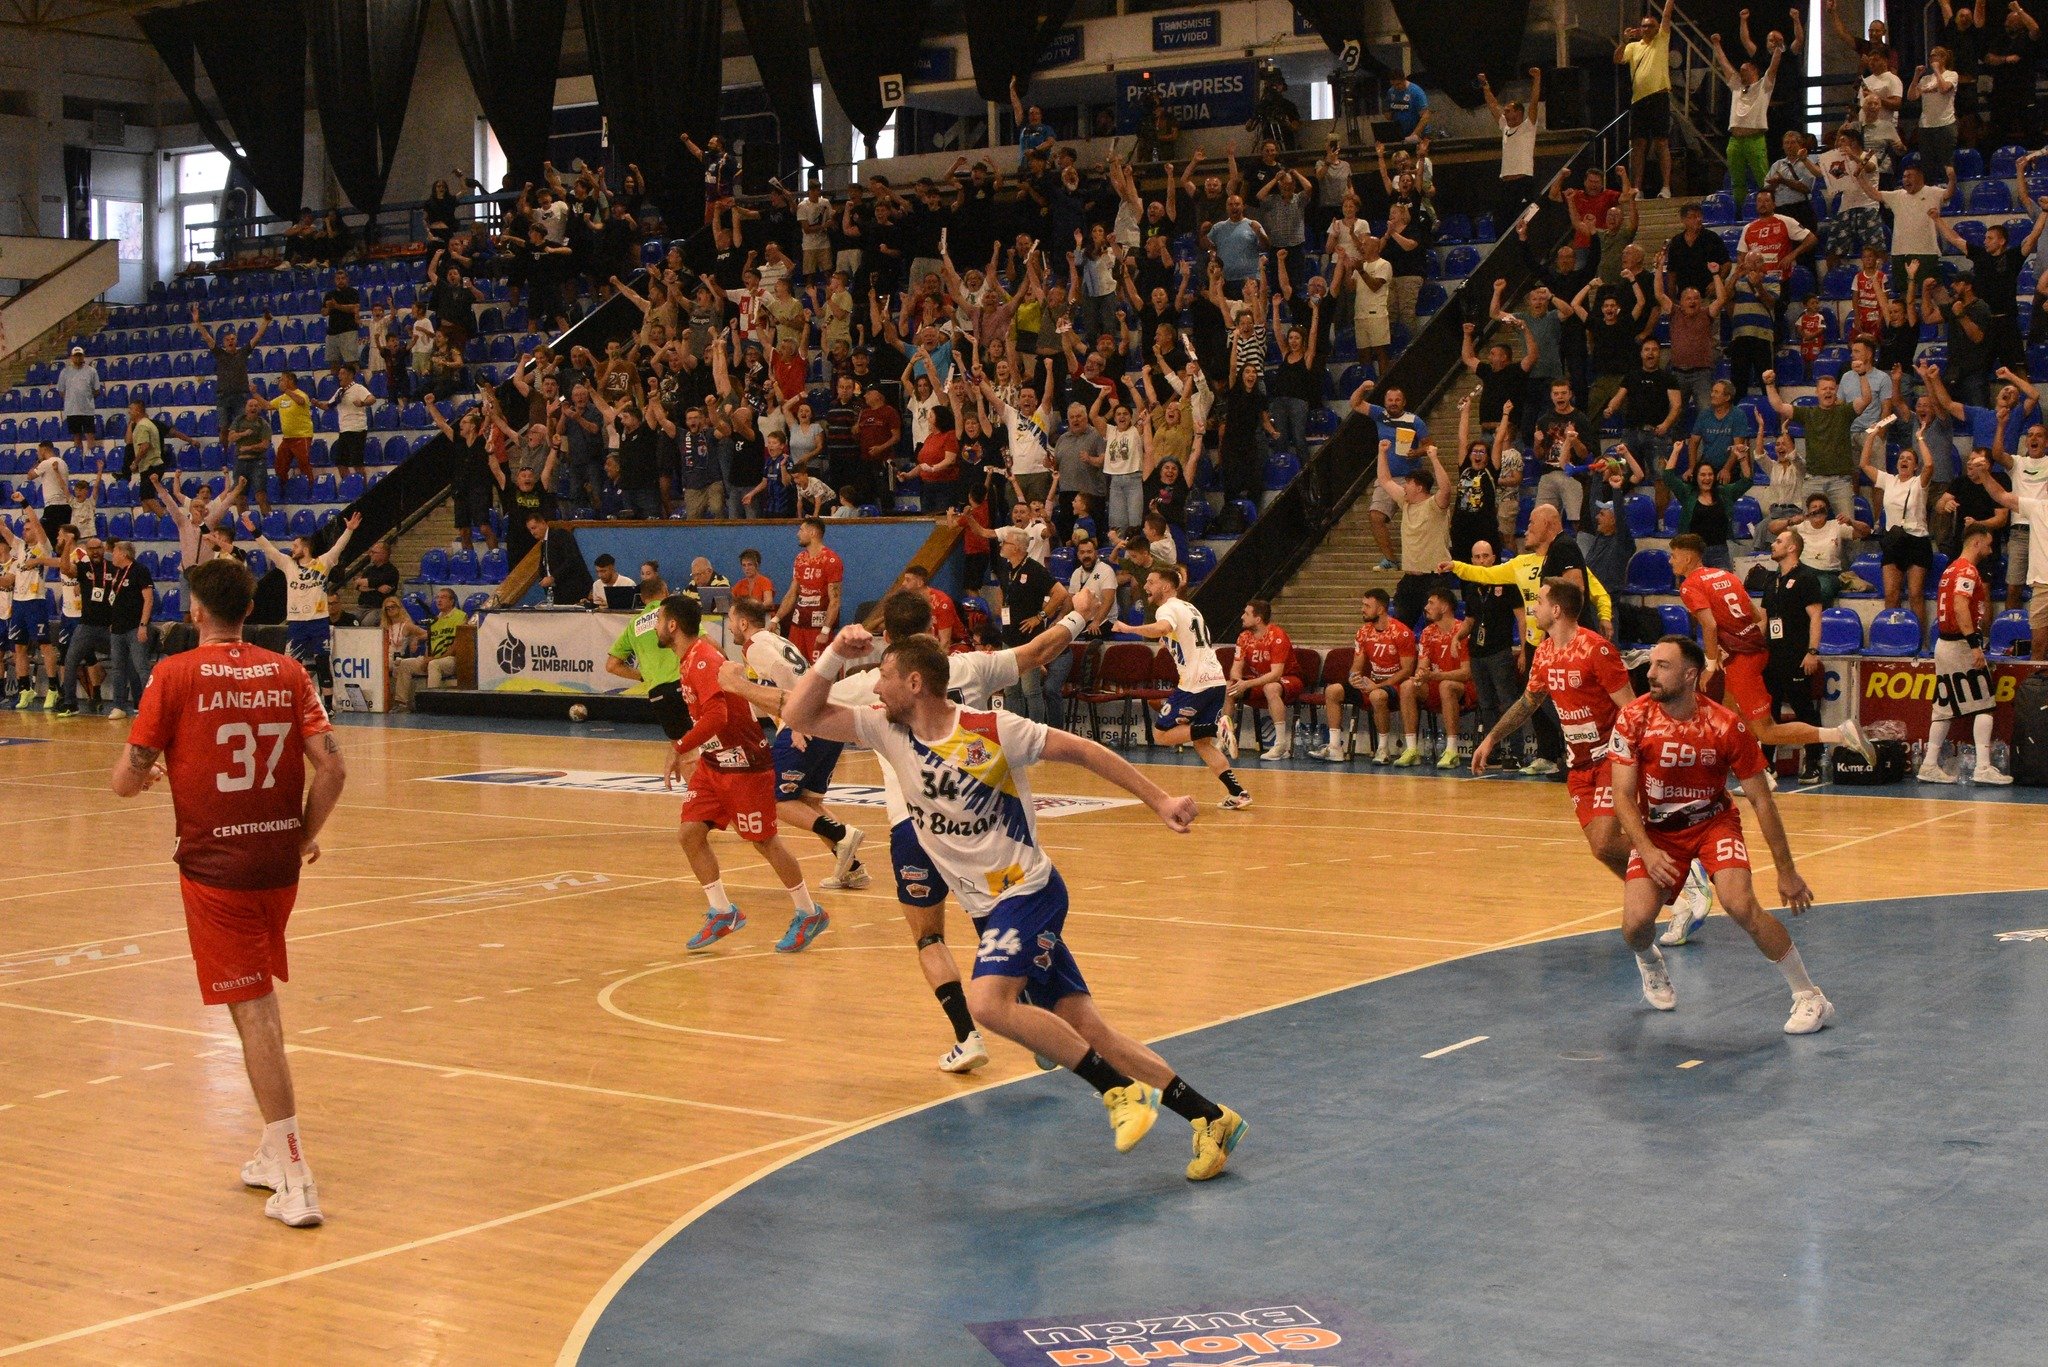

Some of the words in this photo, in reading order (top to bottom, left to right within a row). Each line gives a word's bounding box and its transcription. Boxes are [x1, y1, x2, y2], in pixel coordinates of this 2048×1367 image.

[1159, 17, 1212, 32] TRANSMISIE
[1162, 33, 1175, 44] TV
[1181, 32, 1208, 43] VIDEO
[884, 80, 902, 102] B
[1192, 76, 1243, 96] PRESS
[1167, 103, 1210, 121] EDIA
[607, 372, 629, 390] 23
[1724, 593, 1746, 618] 6
[37, 624, 45, 635] 7
[531, 645, 558, 658] LIGA
[1373, 643, 1386, 657] 77
[1441, 645, 1448, 658] 7
[532, 658, 594, 673] ZIMBRILOR
[783, 646, 808, 676] 9
[201, 663, 280, 680] SUPERBET
[1548, 669, 1565, 691] 55
[1559, 706, 1593, 720] Baumit
[216, 722, 292, 793] 37
[1660, 742, 1696, 767] 59
[921, 769, 960, 801] 34
[1664, 785, 1716, 799] Baumit
[1593, 787, 1614, 808] 55
[736, 811, 763, 834] 66
[1717, 838, 1747, 862] 59
[978, 928, 1022, 956] 34
[212, 972, 262, 991] CARPATINA
[1173, 1081, 1187, 1098] 23
[287, 1133, 300, 1163] Kempa
[1046, 1327, 1341, 1367] Gloria
